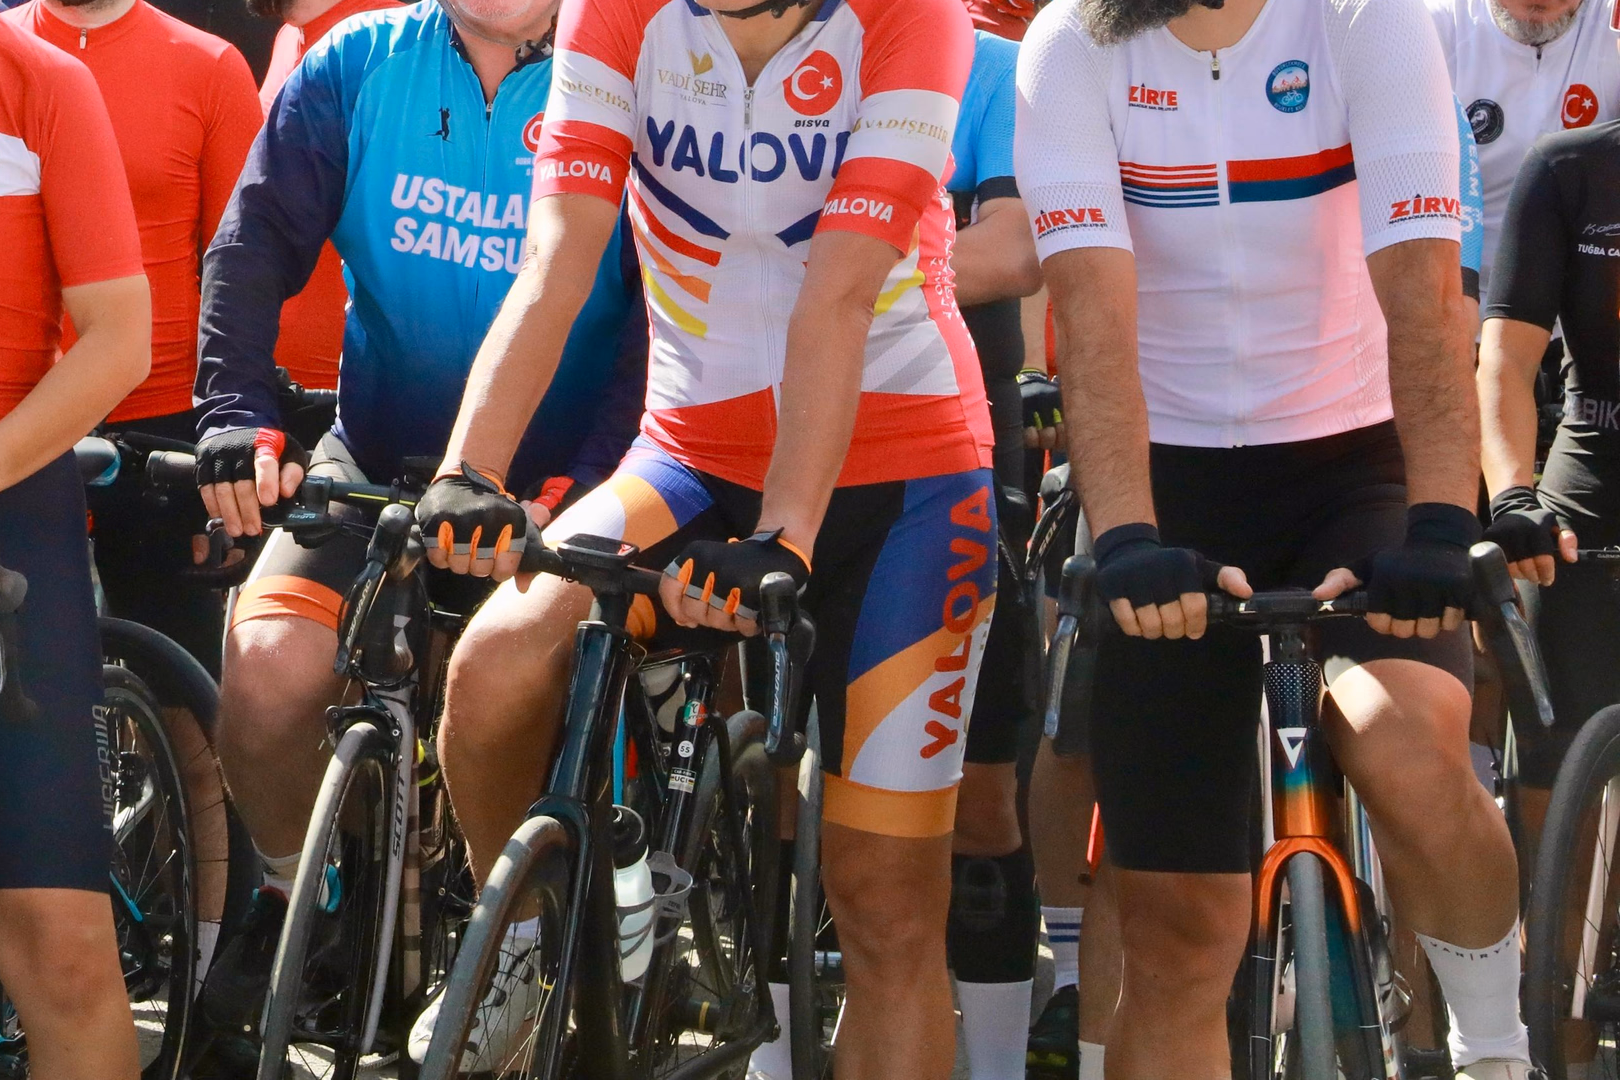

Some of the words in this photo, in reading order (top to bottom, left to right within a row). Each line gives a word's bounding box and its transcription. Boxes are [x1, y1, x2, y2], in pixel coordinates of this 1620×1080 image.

[540, 160, 611, 184] YALOVA
[391, 174, 530, 229] USTALA
[822, 198, 893, 223] YALOVA
[390, 217, 527, 274] SAMSU
[1578, 243, 1605, 256] TUĞBA
[920, 486, 992, 759] YALOVA
[674, 775, 688, 783] UCI
[392, 769, 405, 861] SCOTT
